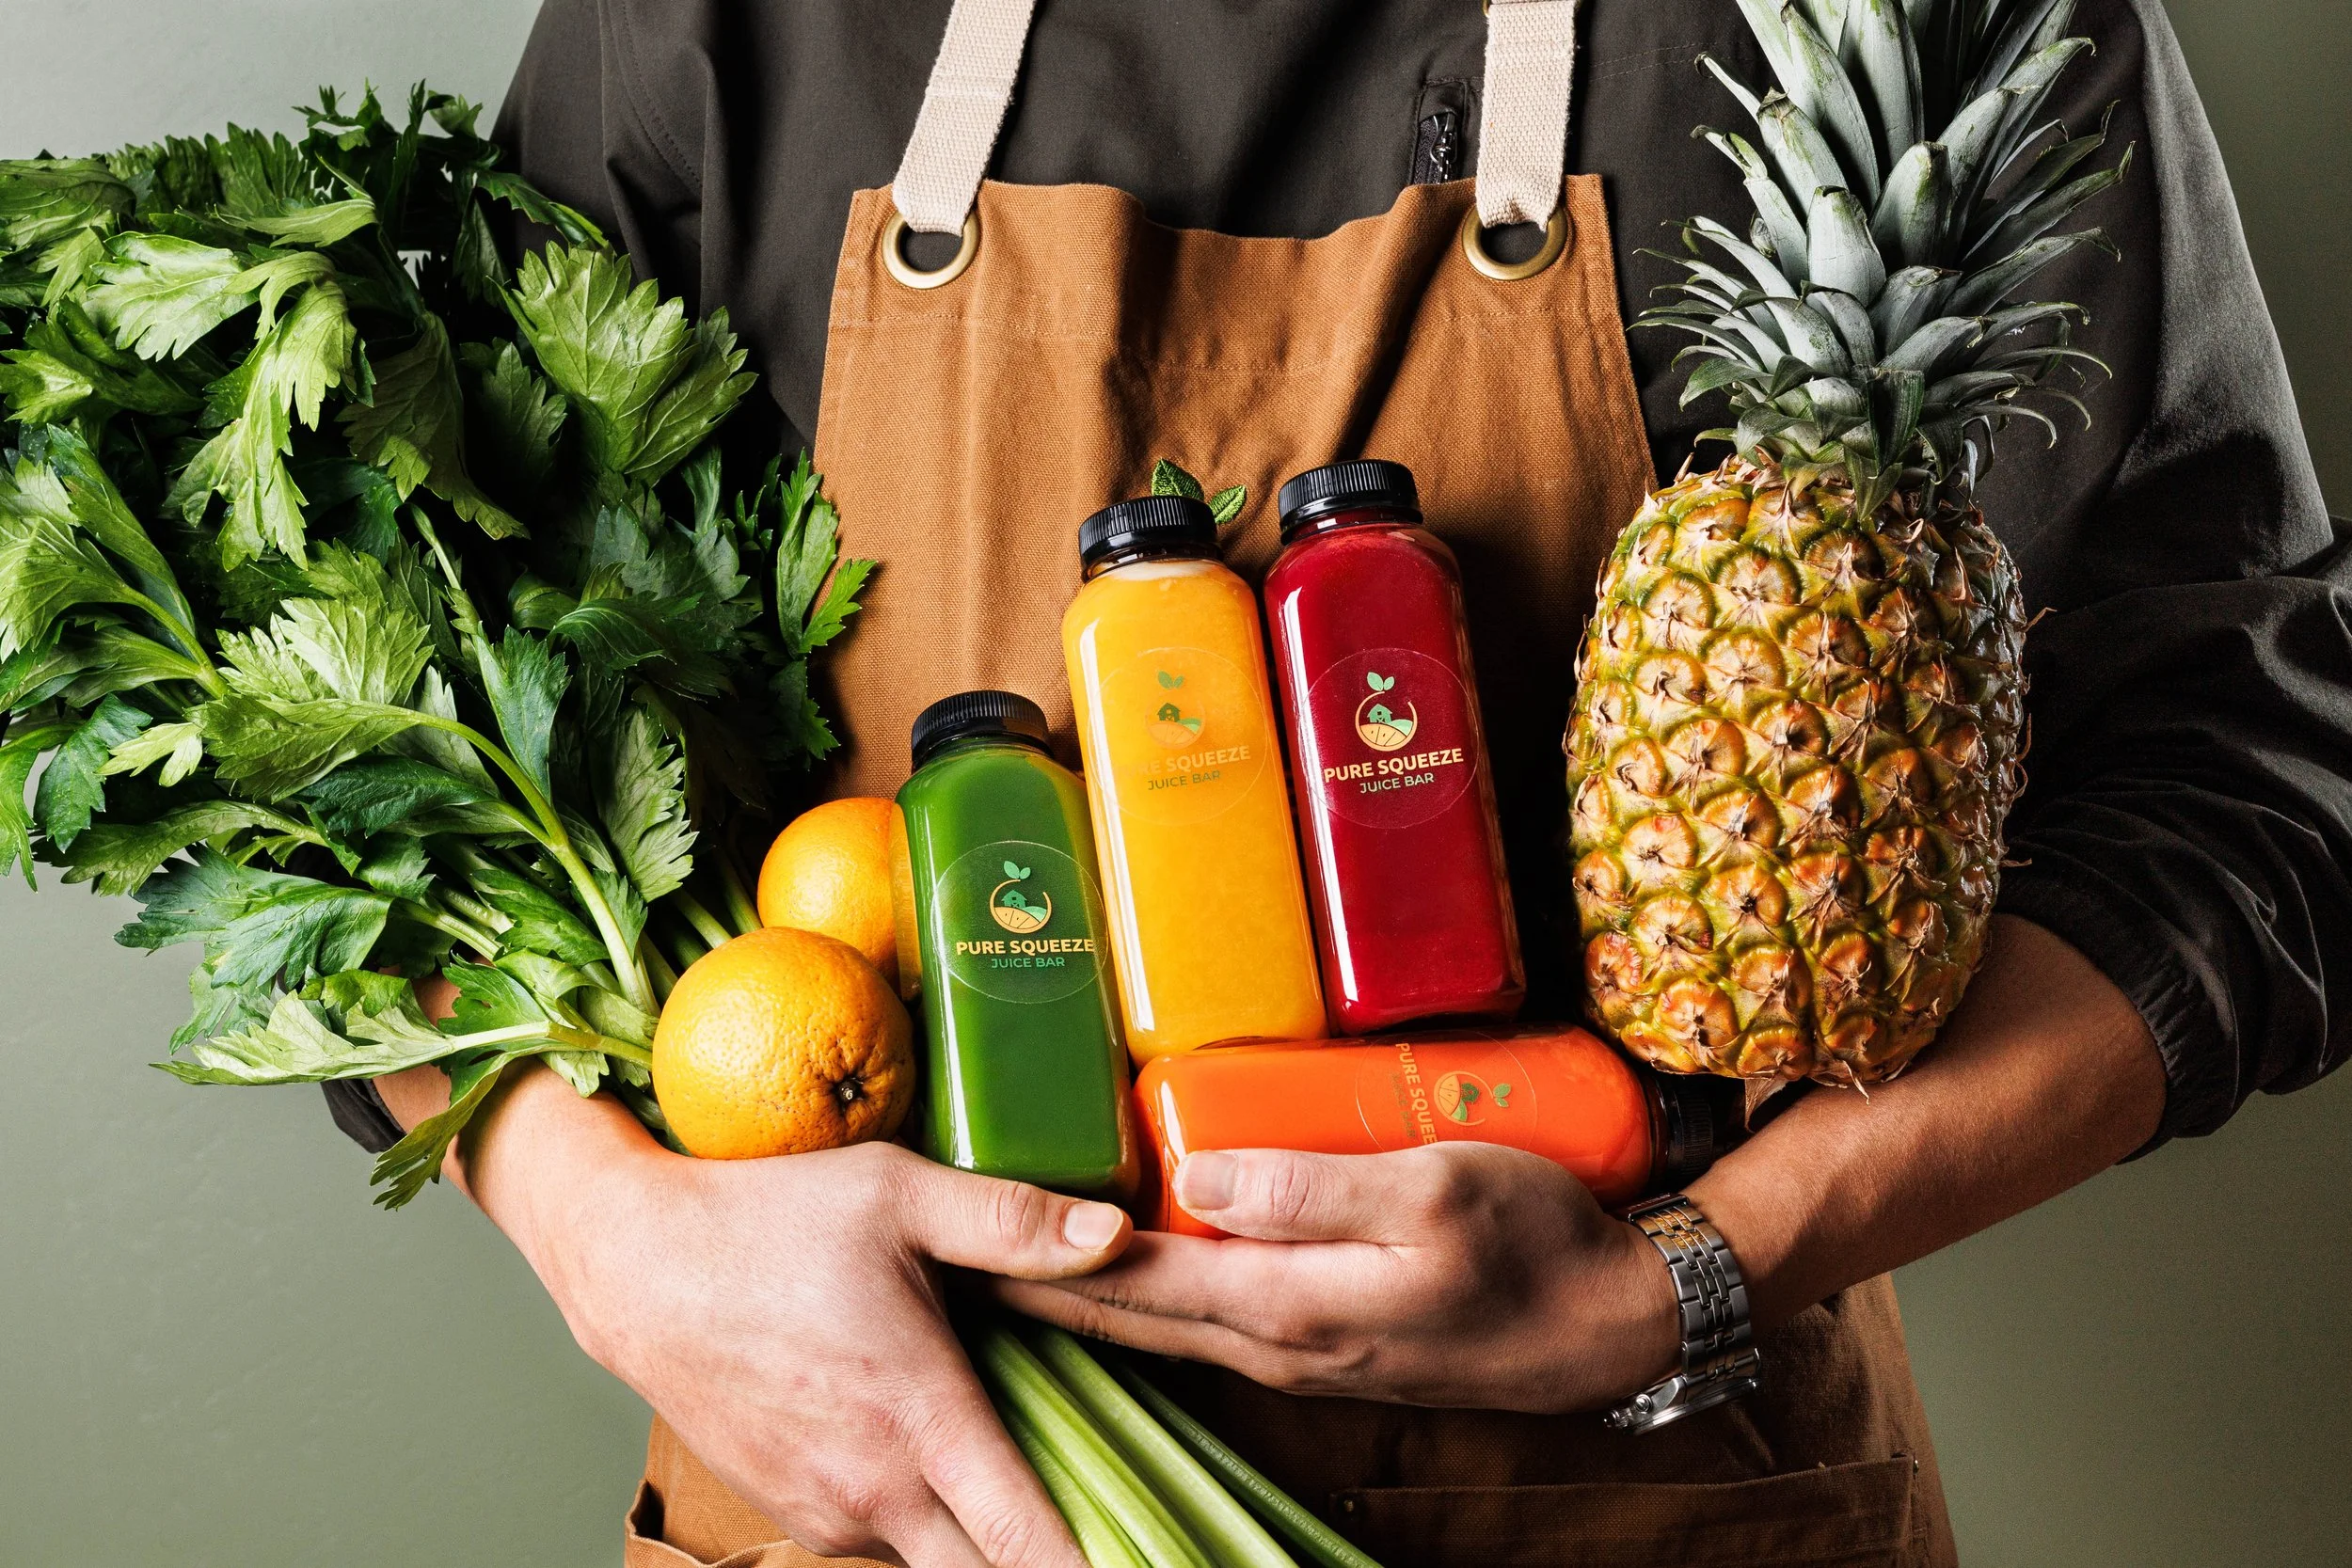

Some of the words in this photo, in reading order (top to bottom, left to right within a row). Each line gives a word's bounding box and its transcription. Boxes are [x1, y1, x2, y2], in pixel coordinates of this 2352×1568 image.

[1166, 745, 1251, 773] SQUEEZE
[1324, 762, 1375, 783] PURE
[1377, 748, 1464, 775] SQUEEZE
[1147, 775, 1187, 791] JUICE
[1192, 769, 1221, 784] BAR
[1359, 777, 1401, 794] JUICE
[1405, 772, 1435, 787] BAR
[956, 941, 1007, 956] PURE
[1009, 939, 1095, 957] SQUEEZE
[991, 958, 1032, 969] JUICE
[1036, 957, 1065, 968] BAR
[1395, 1042, 1422, 1085] PURE
[1409, 1087, 1438, 1145] SQUEE
